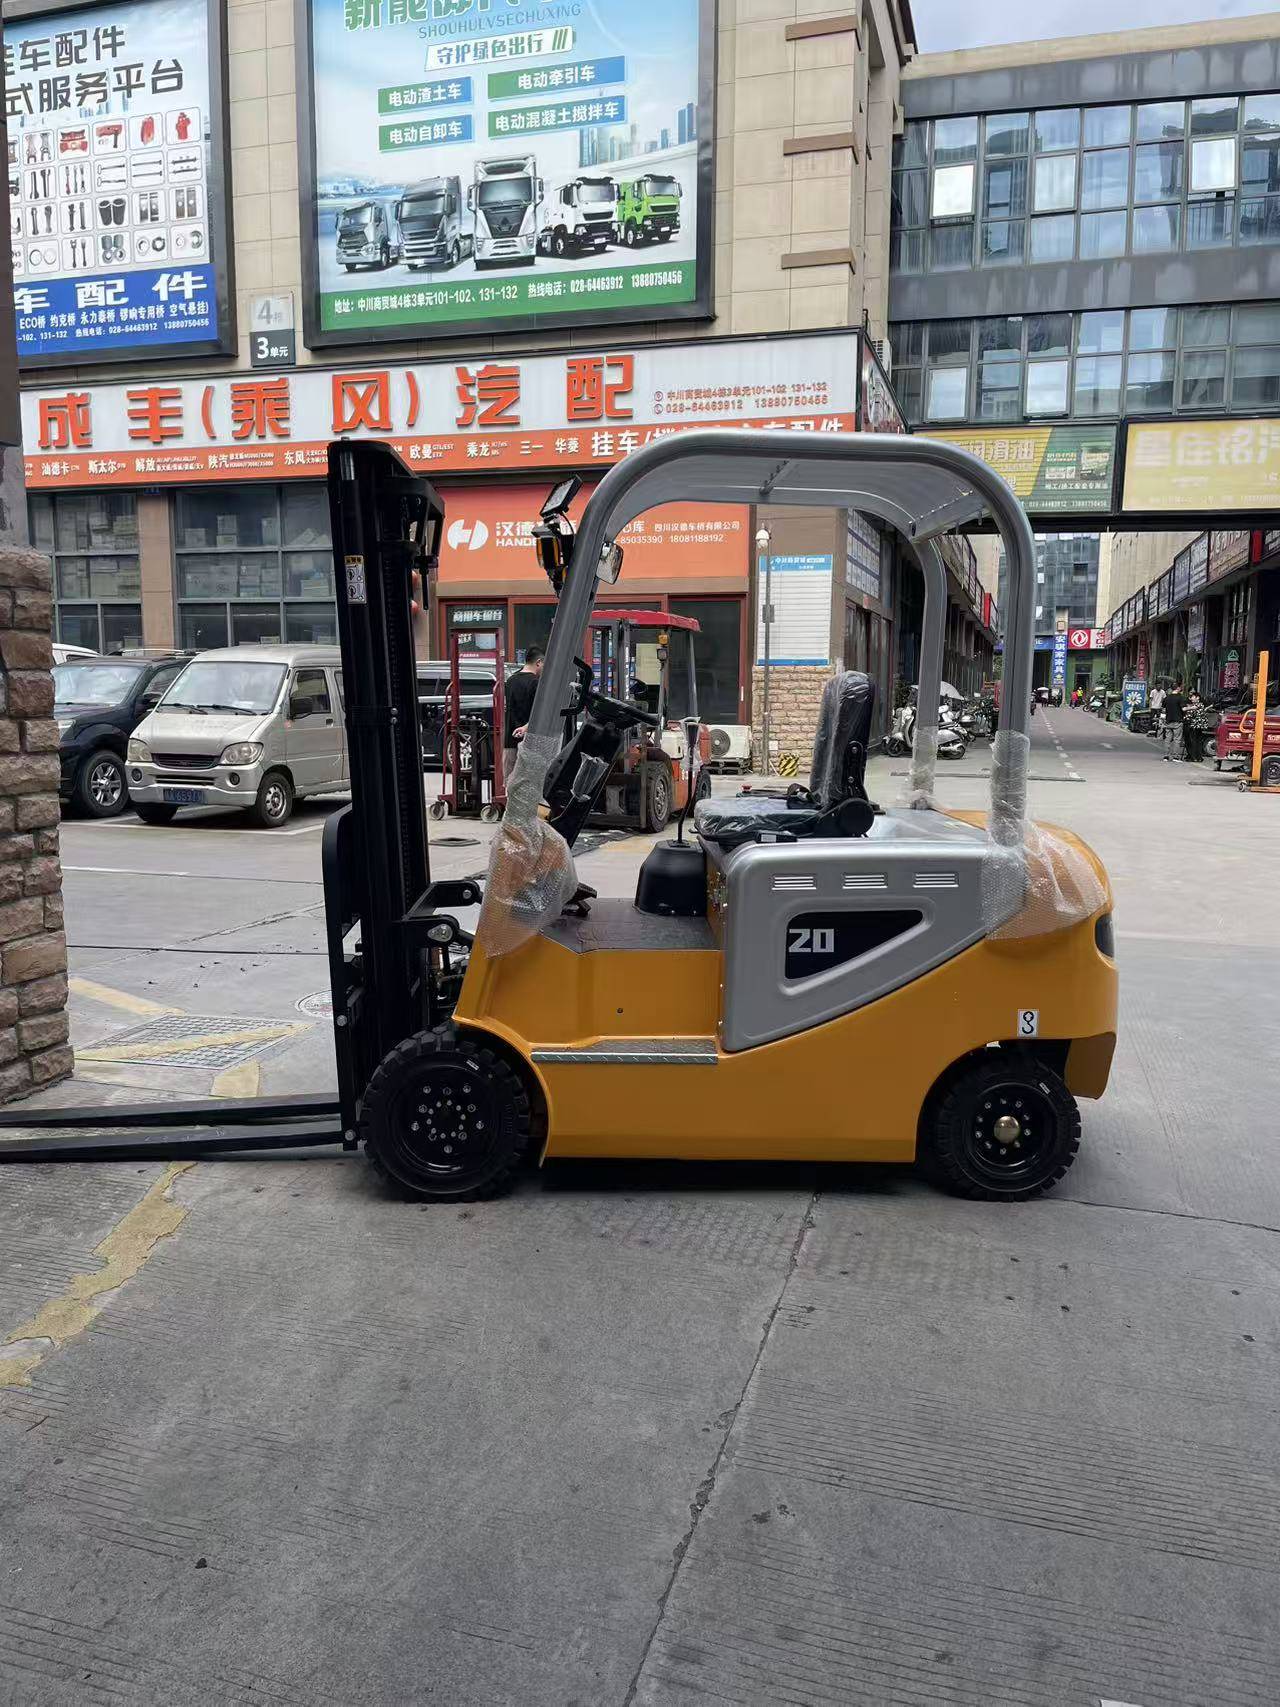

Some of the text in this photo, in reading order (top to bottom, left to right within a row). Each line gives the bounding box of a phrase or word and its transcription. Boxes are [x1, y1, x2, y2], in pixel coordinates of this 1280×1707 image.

[436, 33, 544, 65] 守护绿色出行
[389, 64, 595, 107] 电动渣土车 电动牵引车
[389, 101, 619, 144] 电动自卸车 电动混凝土搅拌车
[788, 929, 834, 953] 20
